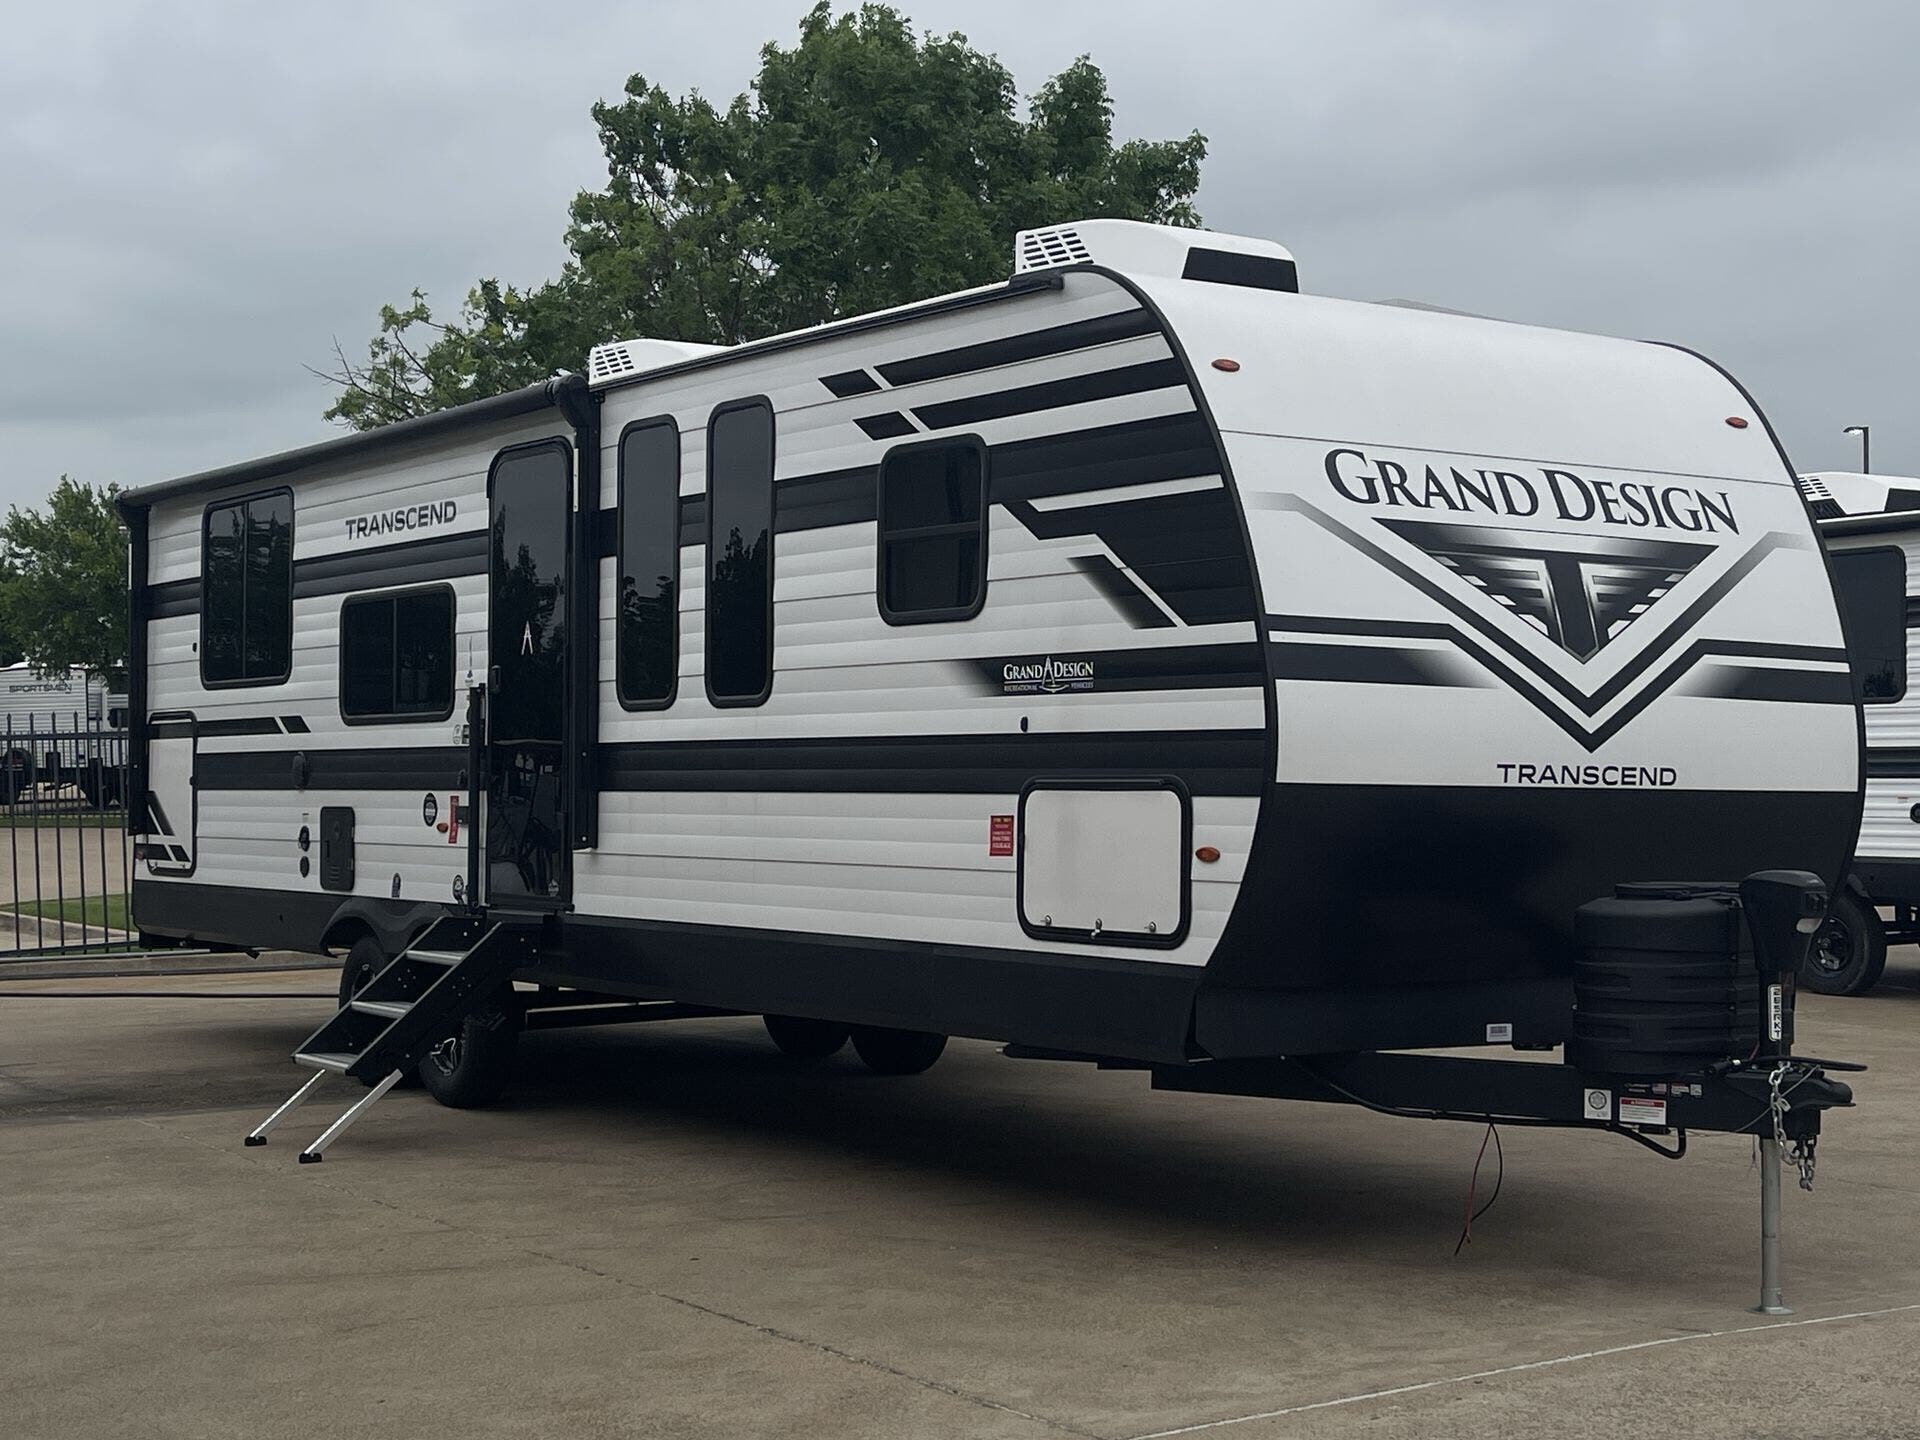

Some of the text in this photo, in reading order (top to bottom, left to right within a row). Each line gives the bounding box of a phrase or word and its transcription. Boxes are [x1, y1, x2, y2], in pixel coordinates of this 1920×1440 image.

[1324, 448, 1740, 536] GRAND DESIGN
[345, 501, 457, 540] TRANSCEND
[1003, 661, 1094, 680] GRAND DESIGN
[1496, 763, 1677, 787] TRANSCEND
